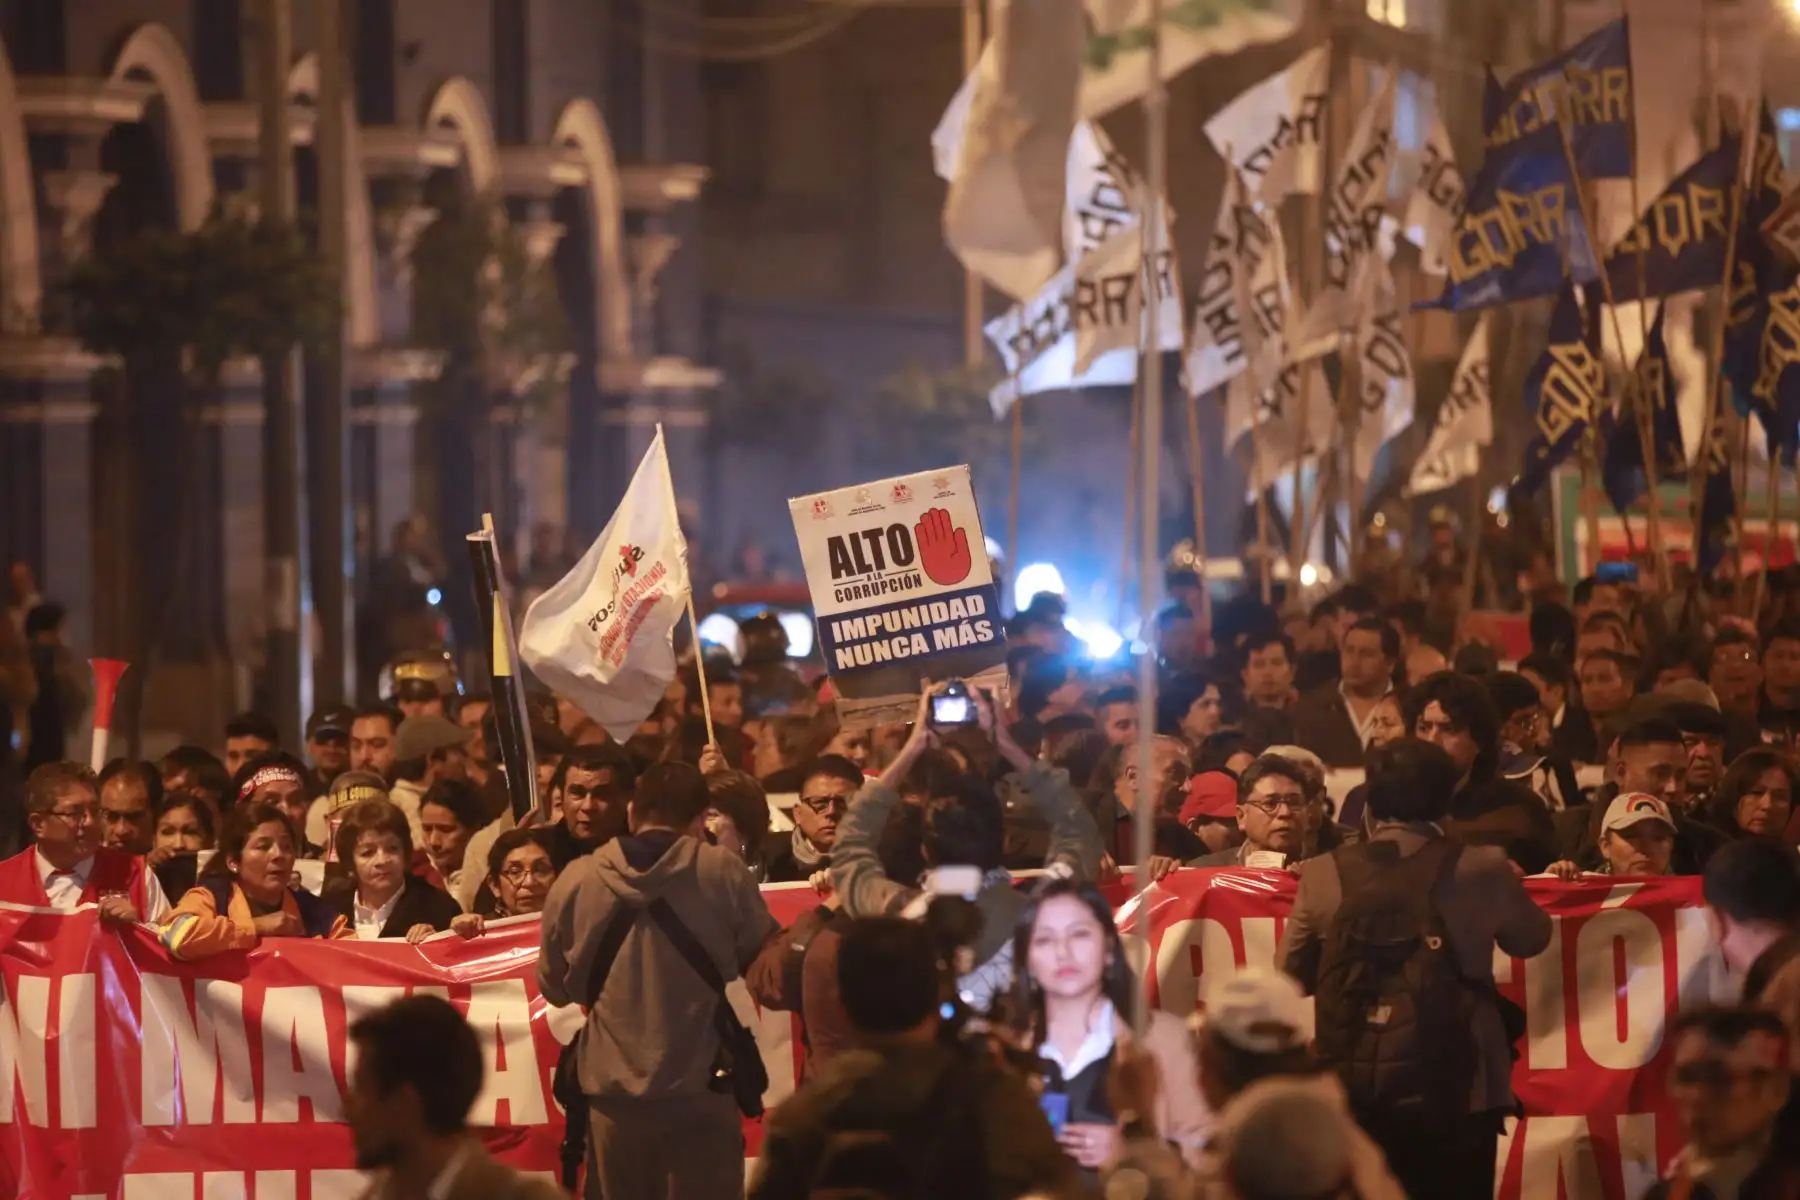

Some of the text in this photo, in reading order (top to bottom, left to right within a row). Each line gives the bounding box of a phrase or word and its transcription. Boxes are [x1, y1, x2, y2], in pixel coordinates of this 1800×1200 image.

[827, 523, 915, 580] ALTO
[834, 573, 923, 603] CORRUPCIÓN
[866, 572, 883, 582] A LA
[831, 594, 986, 643] IMPUNIDAD
[835, 619, 994, 670] NUNCA MÁS
